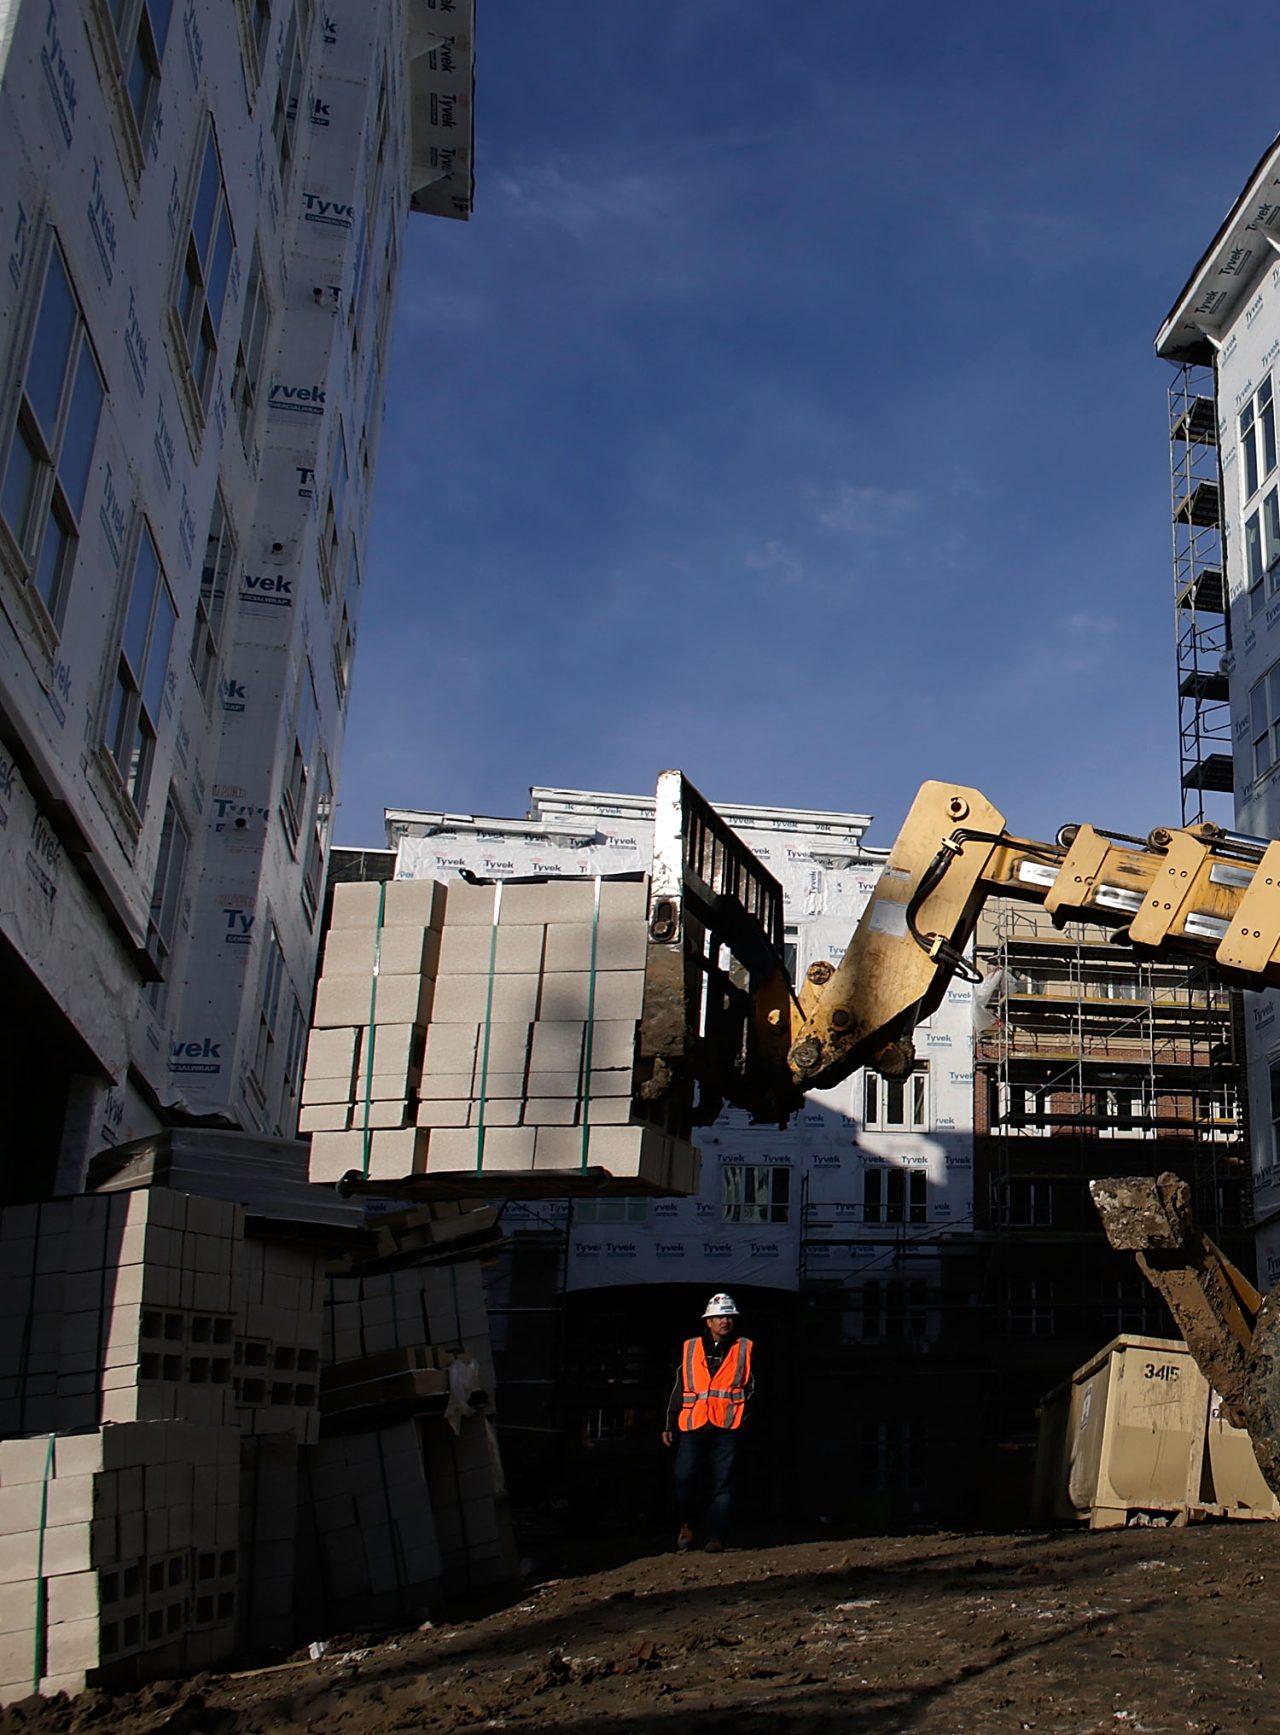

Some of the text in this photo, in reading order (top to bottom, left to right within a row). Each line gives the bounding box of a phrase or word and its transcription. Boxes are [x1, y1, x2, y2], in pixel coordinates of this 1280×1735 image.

[439, 95, 457, 128] Tyvek
[1219, 247, 1245, 276] Tyvek
[1194, 290, 1219, 314] Tyvek
[608, 836, 637, 846] Tyvek
[436, 857, 466, 867] Tyvek
[484, 860, 513, 870] Tyvek
[533, 863, 561, 873] Tyvek
[926, 1034, 951, 1043] Tyvek
[813, 1155, 840, 1164] Tyvek
[902, 1155, 928, 1164] Tyvek
[945, 1155, 971, 1164] Tyvek
[655, 1242, 684, 1252] Tyvek
[1144, 1363, 1180, 1382] 3415
